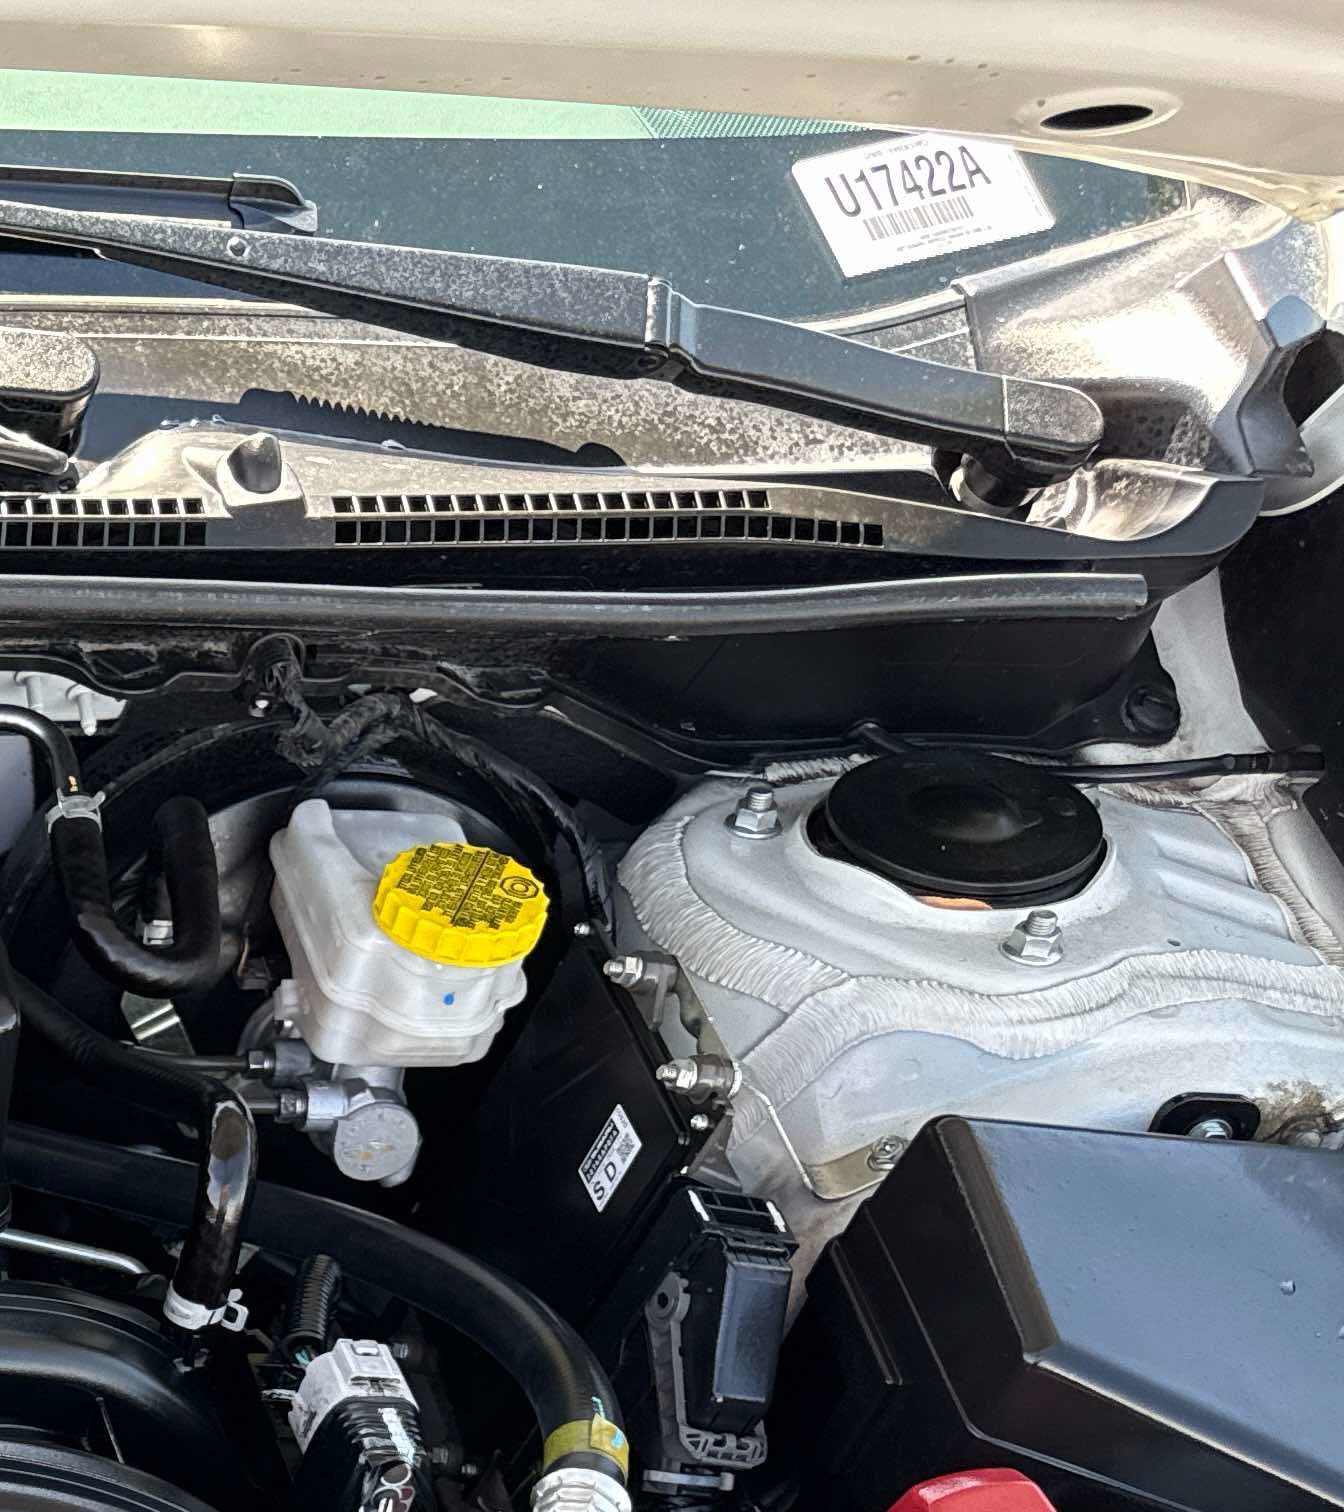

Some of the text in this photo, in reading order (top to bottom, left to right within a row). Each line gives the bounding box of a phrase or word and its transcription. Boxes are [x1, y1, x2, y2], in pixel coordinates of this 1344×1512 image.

[824, 146, 992, 217] U17422A
[592, 1181, 606, 1201] S
[603, 1160, 618, 1183] D
